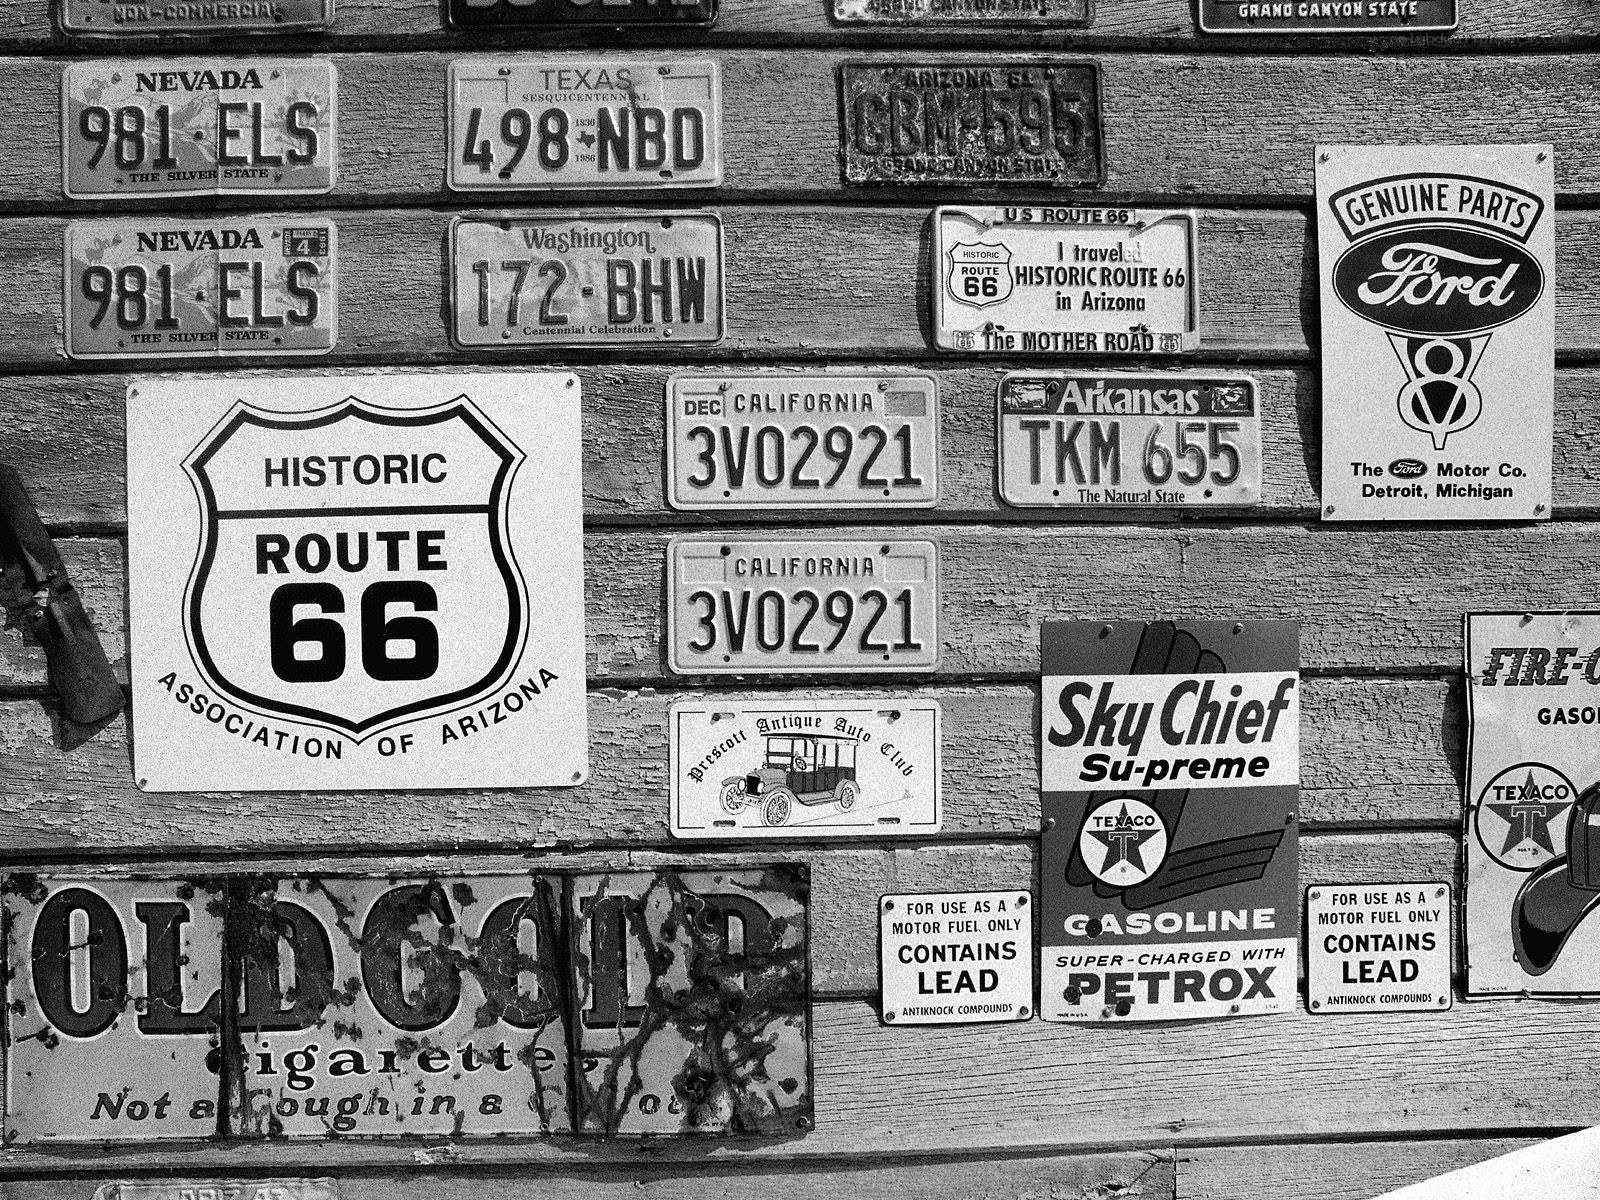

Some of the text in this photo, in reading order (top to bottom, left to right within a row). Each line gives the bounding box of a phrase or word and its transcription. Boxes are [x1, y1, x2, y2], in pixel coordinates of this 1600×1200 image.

[1238, 2, 1417, 17] GRAND CANYON STATE
[136, 69, 263, 93] NEVADA
[540, 69, 632, 90] TEXAS
[905, 70, 996, 88] ARIZONA
[522, 93, 650, 103] SESQUICENTENNIAL
[575, 118, 595, 127] 1836
[80, 101, 318, 170] 981 ELS
[462, 106, 704, 173] 498 NBD
[575, 154, 595, 163] 1986
[129, 169, 269, 183] THE SILVER STATE
[1346, 183, 1531, 228] GENUINE PARTS
[1043, 209, 1105, 223] ROUTE
[1107, 209, 1129, 222] 66
[137, 228, 263, 252] NEVADA
[297, 239, 310, 255] 4
[523, 228, 656, 254] Washington
[963, 251, 1000, 259] HISTORIC
[1058, 242, 1063, 262] I
[961, 267, 1000, 276] ROUTE
[1016, 266, 1185, 288] HISTORIC ROUTE 66
[1357, 242, 1521, 307] Ford
[82, 261, 319, 330] 981 ELS
[964, 277, 998, 297] 66
[1057, 291, 1145, 311] in Arizona
[131, 331, 269, 344] THE SILVER STATE
[523, 326, 656, 336] Centennial Celebration
[984, 332, 1154, 350] The MOTHER ROAD
[685, 400, 720, 415] DEC
[735, 393, 873, 413] CALIFORNIA
[1056, 381, 1199, 415] Arkansas
[1020, 420, 1242, 486] TKM 655
[265, 453, 448, 487] HISTORIC
[1351, 462, 1527, 477] The Ford Motor Co.
[1078, 488, 1185, 503] The Natural State
[1362, 483, 1513, 500] Detroit, Michigan
[256, 530, 448, 575] ROUTE
[735, 557, 874, 577] CALIFORNIA
[270, 580, 439, 683] 66
[157, 671, 342, 759] ASSOCIATION
[441, 667, 558, 745] ARIZONA
[1537, 706, 1600, 725] GASO
[1048, 678, 1296, 756] Sky Chief
[377, 734, 414, 757] OF
[687, 715, 914, 784] Prescott Antique Auto Club
[1079, 753, 1270, 787] Su-preme
[1493, 784, 1569, 801] TEXACO
[1093, 815, 1155, 828] TEXACO
[907, 900, 1006, 915] FOR USE AS A
[1332, 891, 1426, 905] FOR USE AS A
[892, 919, 1021, 935] MOTOR FUEL ONLY
[1064, 908, 1275, 936] GASOLINE
[1318, 910, 1440, 924] MOTOR FUEL ONLY
[898, 941, 1017, 964] CONTAINS
[1323, 932, 1436, 954] CONTAINS
[1055, 948, 1286, 968] SUPER-CHARGED WITH
[1342, 959, 1419, 983] LEAD
[918, 969, 999, 994] LEAD
[1068, 966, 1277, 1006] PETROX
[1327, 993, 1432, 1005] ANTIKNOCK COMPOUNDS
[902, 1004, 1013, 1016] ANTIKNOCK COMPOUNDS
[90, 1092, 171, 1120] Not
[189, 1098, 216, 1120] a
[411, 1087, 456, 1116] in
[479, 1094, 503, 1116] a
